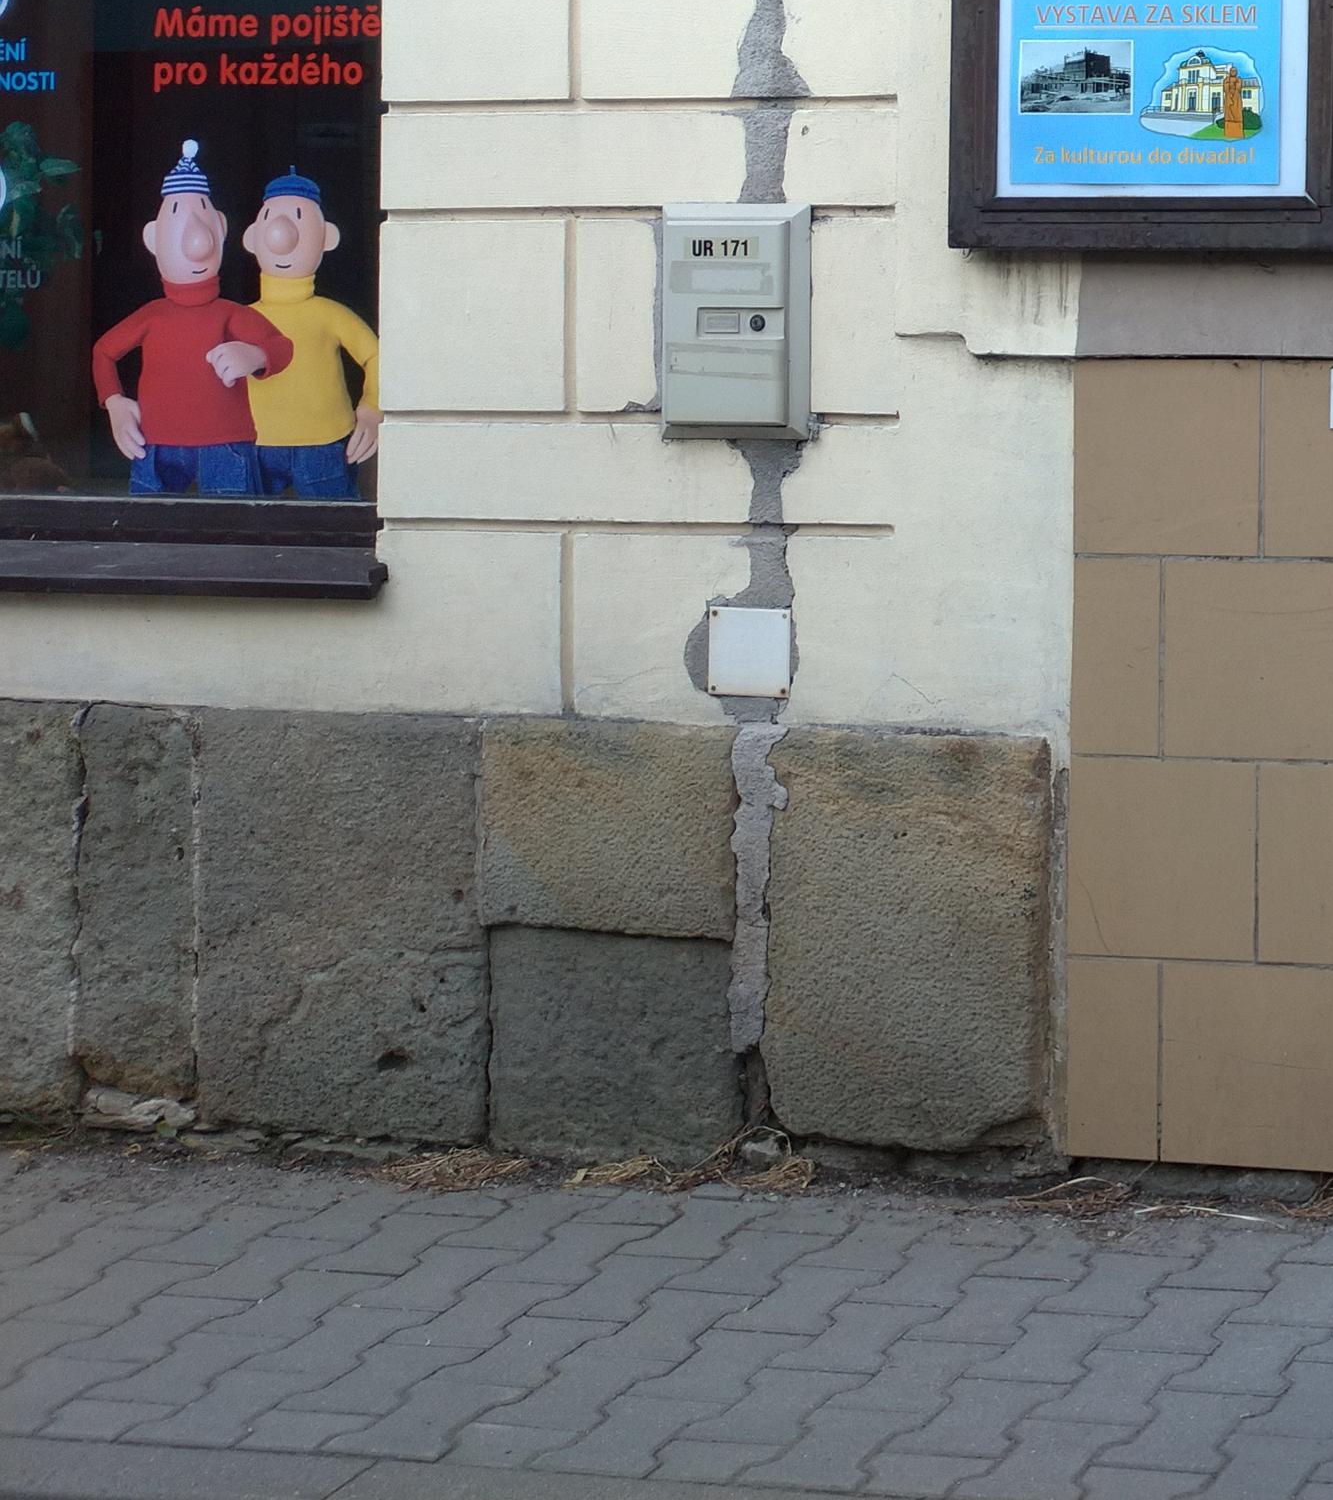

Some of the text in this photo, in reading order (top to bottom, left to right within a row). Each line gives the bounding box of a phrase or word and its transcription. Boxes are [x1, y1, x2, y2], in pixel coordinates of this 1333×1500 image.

[1035, 1, 1257, 24] VÝSTAVA ZA SKLEM
[154, 5, 382, 45] Máme pojiště
[0, 71, 55, 91] NOSTI
[153, 52, 363, 93] pro každého
[1034, 146, 1256, 165] Za kulturou do divadla!
[691, 239, 749, 257] UR 171
